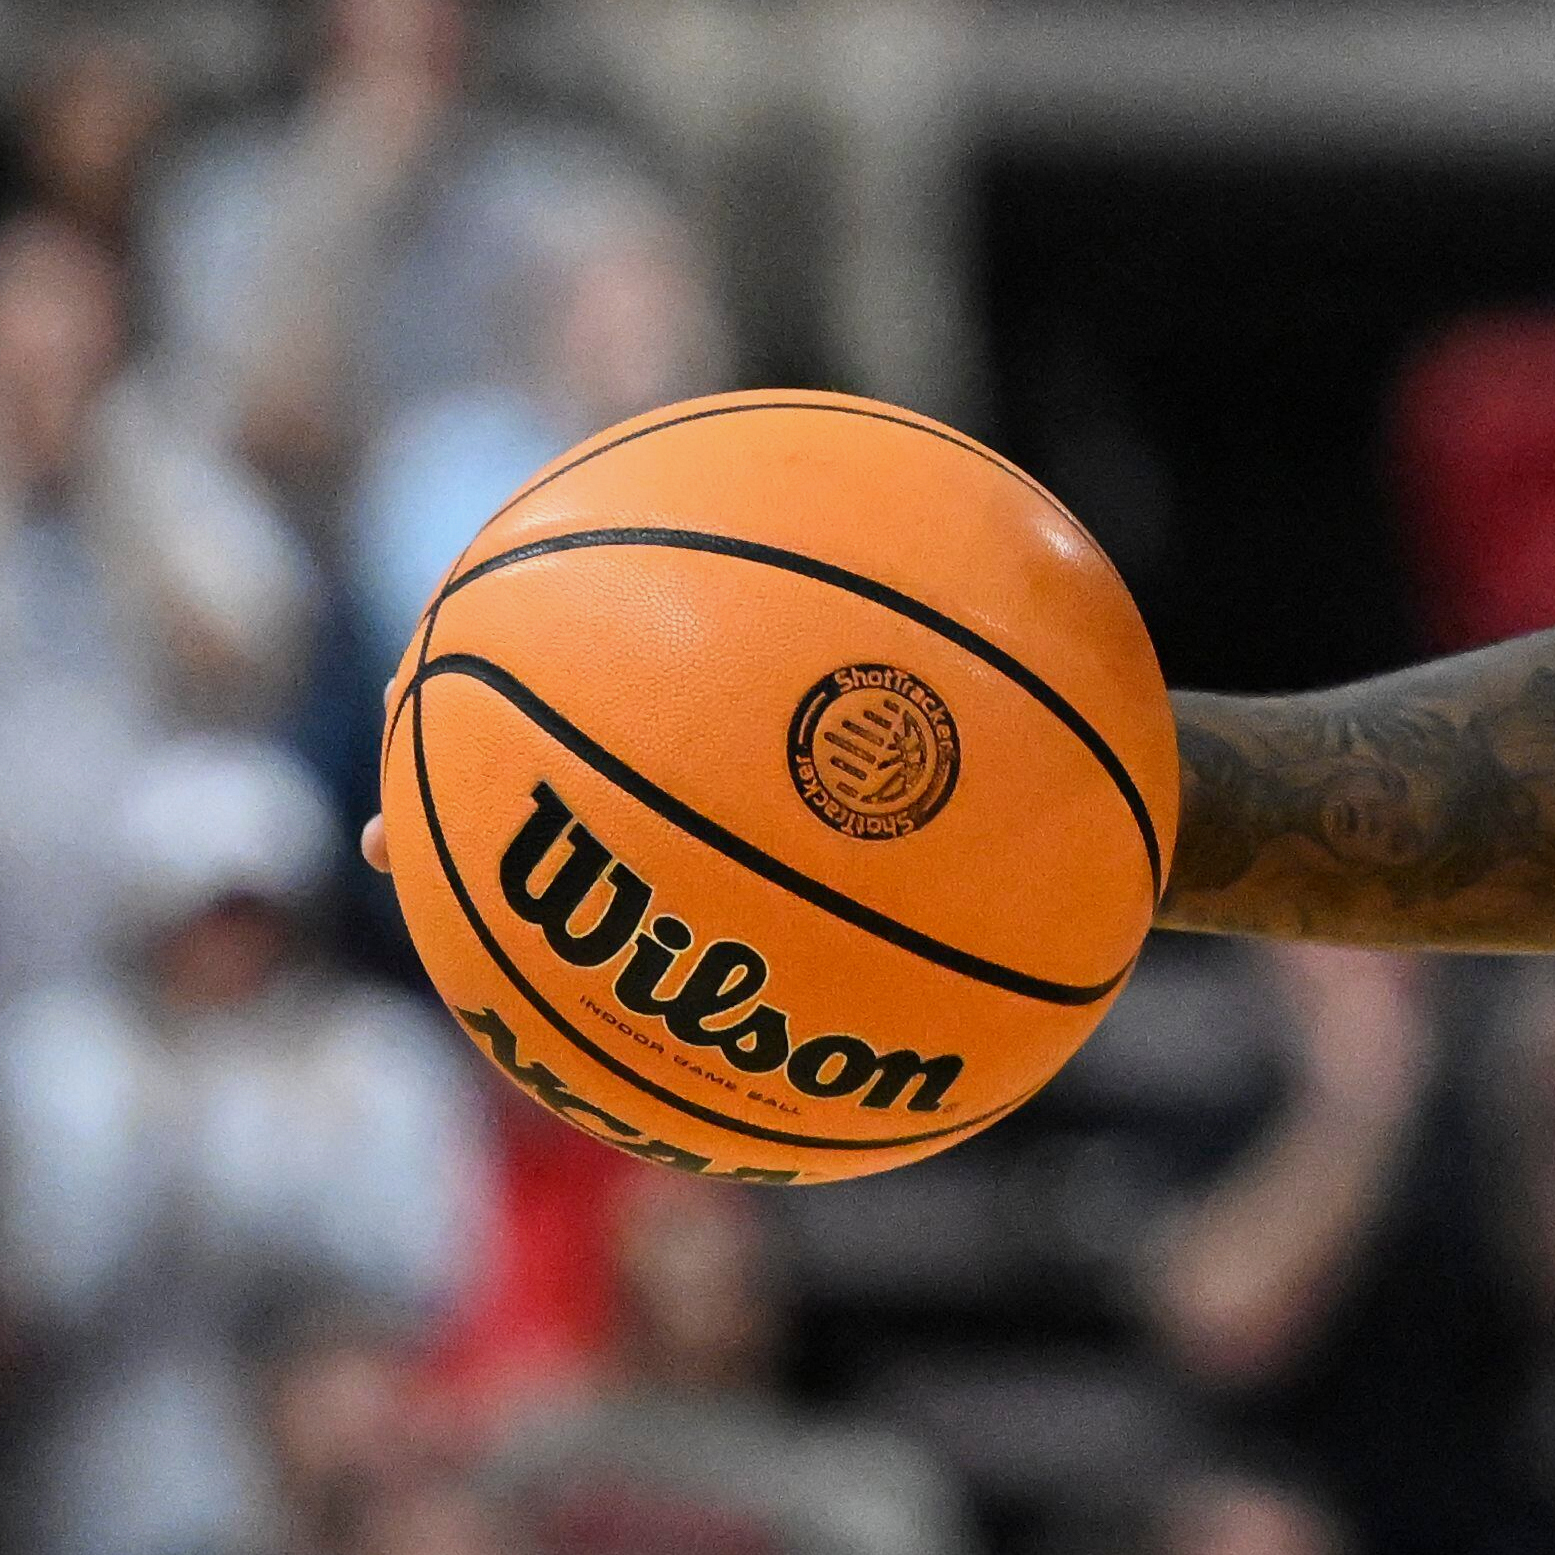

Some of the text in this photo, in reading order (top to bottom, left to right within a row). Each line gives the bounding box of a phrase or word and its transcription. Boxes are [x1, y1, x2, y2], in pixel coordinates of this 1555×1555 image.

[833, 667, 954, 750] ShotTracker
[795, 753, 915, 837] ShotTracker
[498, 779, 965, 1114] Wilson
[579, 994, 802, 1116] INDOOR GAME BALL
